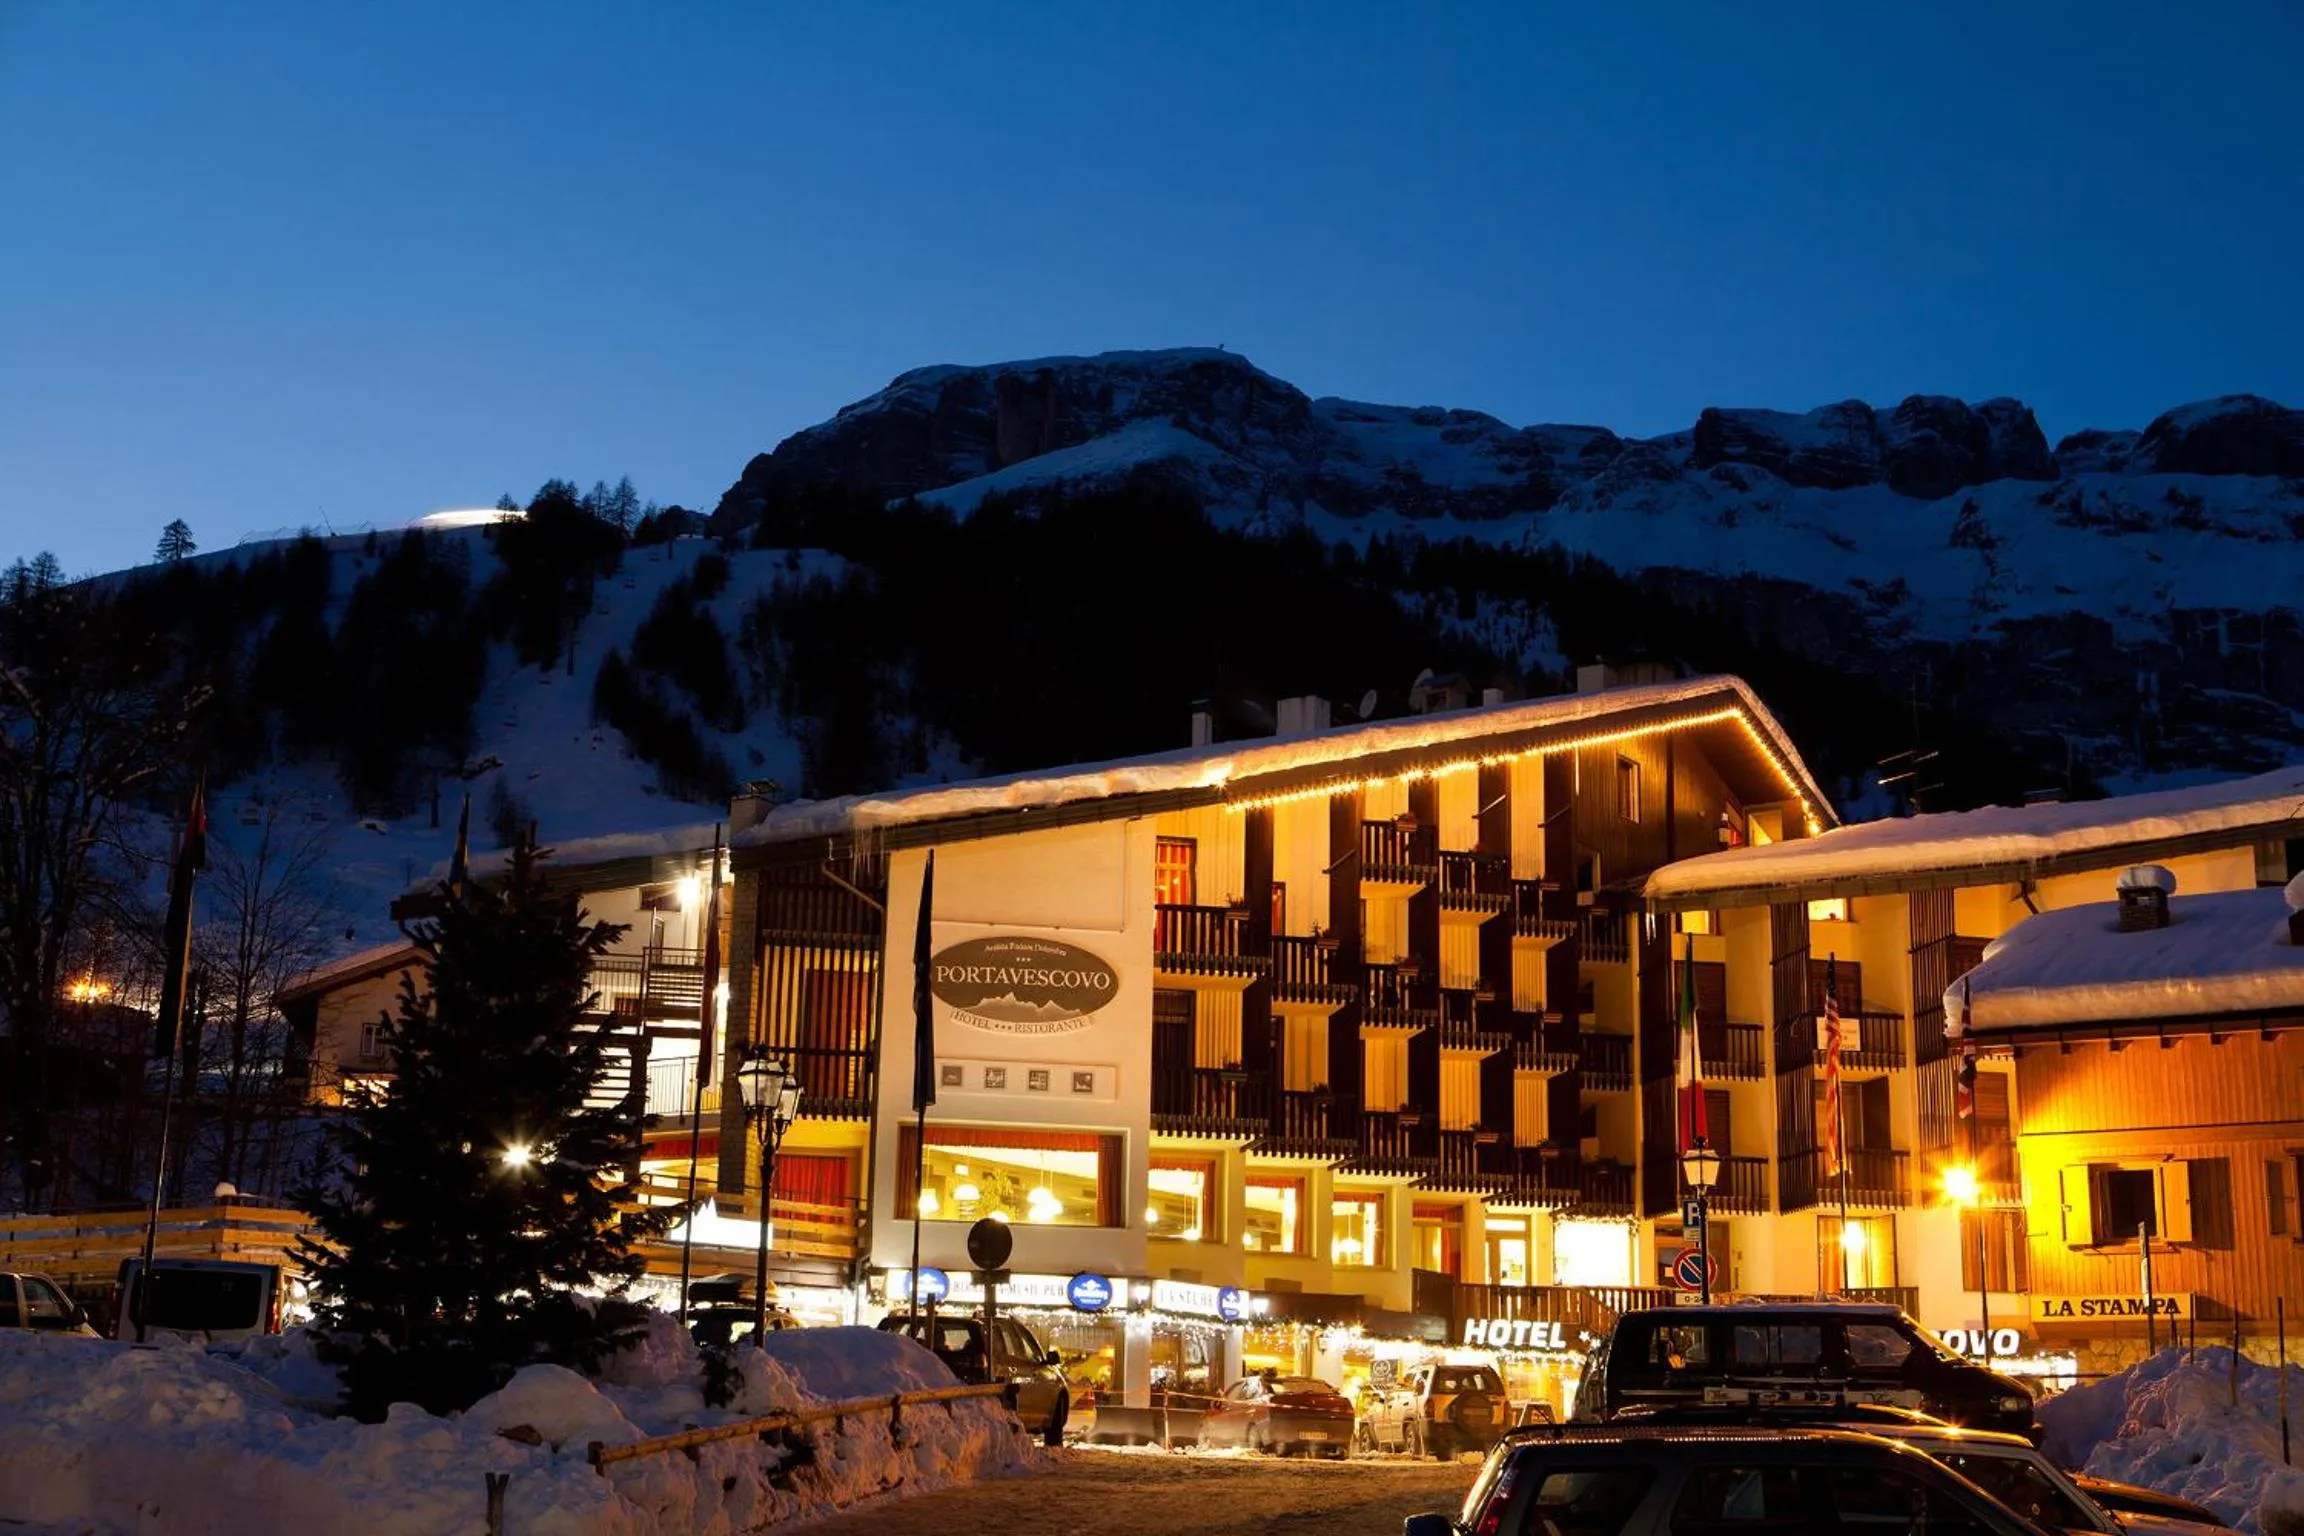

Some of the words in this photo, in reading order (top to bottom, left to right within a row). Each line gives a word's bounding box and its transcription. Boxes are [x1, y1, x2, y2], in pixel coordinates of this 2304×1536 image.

[936, 965, 1110, 990] PORTAVESCOVO
[953, 1010, 991, 1030] HOTEL
[1014, 1018, 1086, 1034] RISTORANTE
[1687, 1202, 1701, 1225] P
[2042, 1300, 2075, 1317] LA
[2080, 1298, 2182, 1317] STAMPA
[1463, 1317, 1567, 1348] HOTEL
